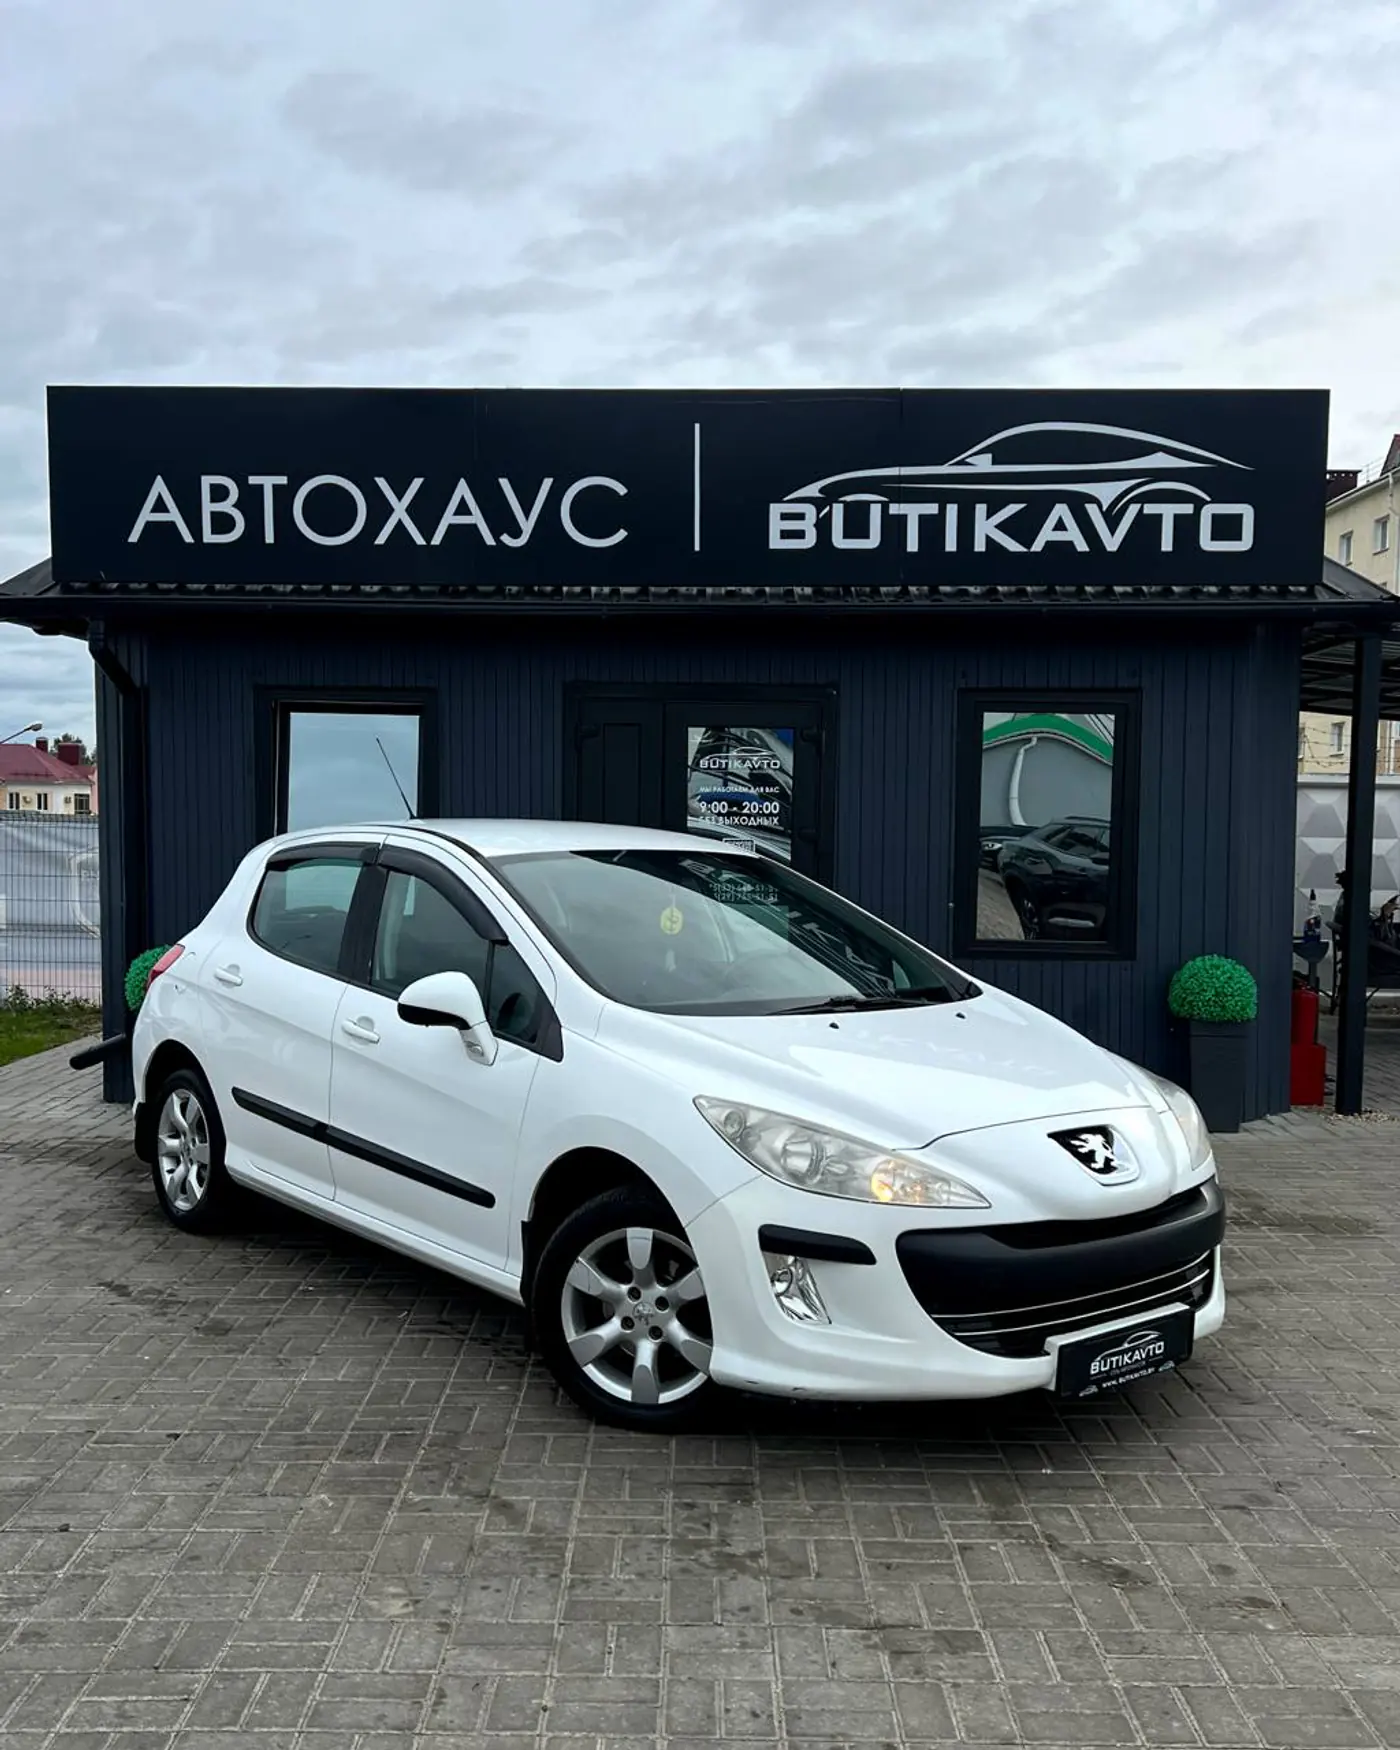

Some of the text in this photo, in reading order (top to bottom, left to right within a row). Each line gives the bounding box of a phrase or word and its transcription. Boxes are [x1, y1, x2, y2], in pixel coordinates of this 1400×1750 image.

[128, 474, 628, 548] АВТОХАУС
[768, 502, 1255, 553] BUTIKAVTO
[700, 759, 780, 769] BUTIKAVTO
[699, 801, 728, 813] 9:00
[742, 801, 780, 814] 20:00
[1090, 1342, 1164, 1374] BUTIKAVTO
